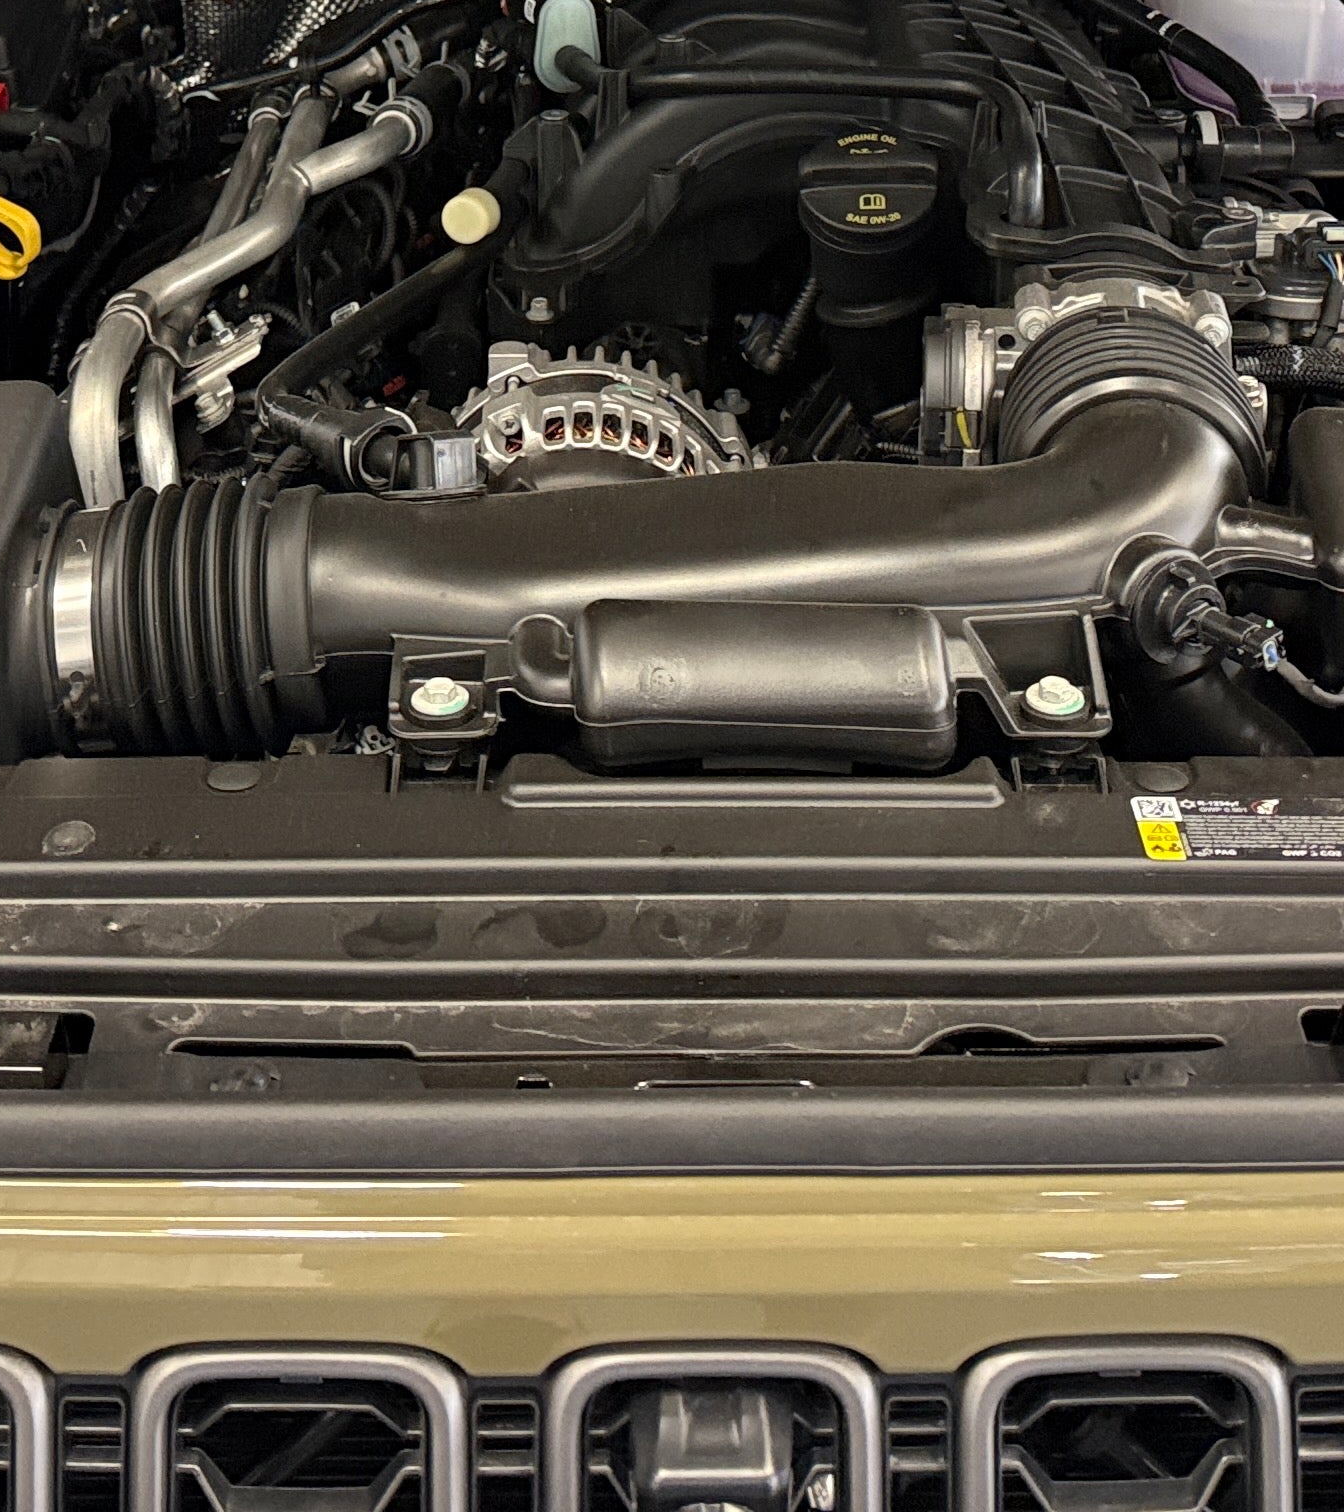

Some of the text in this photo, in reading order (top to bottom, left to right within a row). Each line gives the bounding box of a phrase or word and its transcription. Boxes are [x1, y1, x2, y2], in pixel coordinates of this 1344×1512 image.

[837, 134, 897, 147] ENGINE OIL
[846, 212, 901, 224] SAE 0W-20
[1214, 848, 1238, 856] PAG
